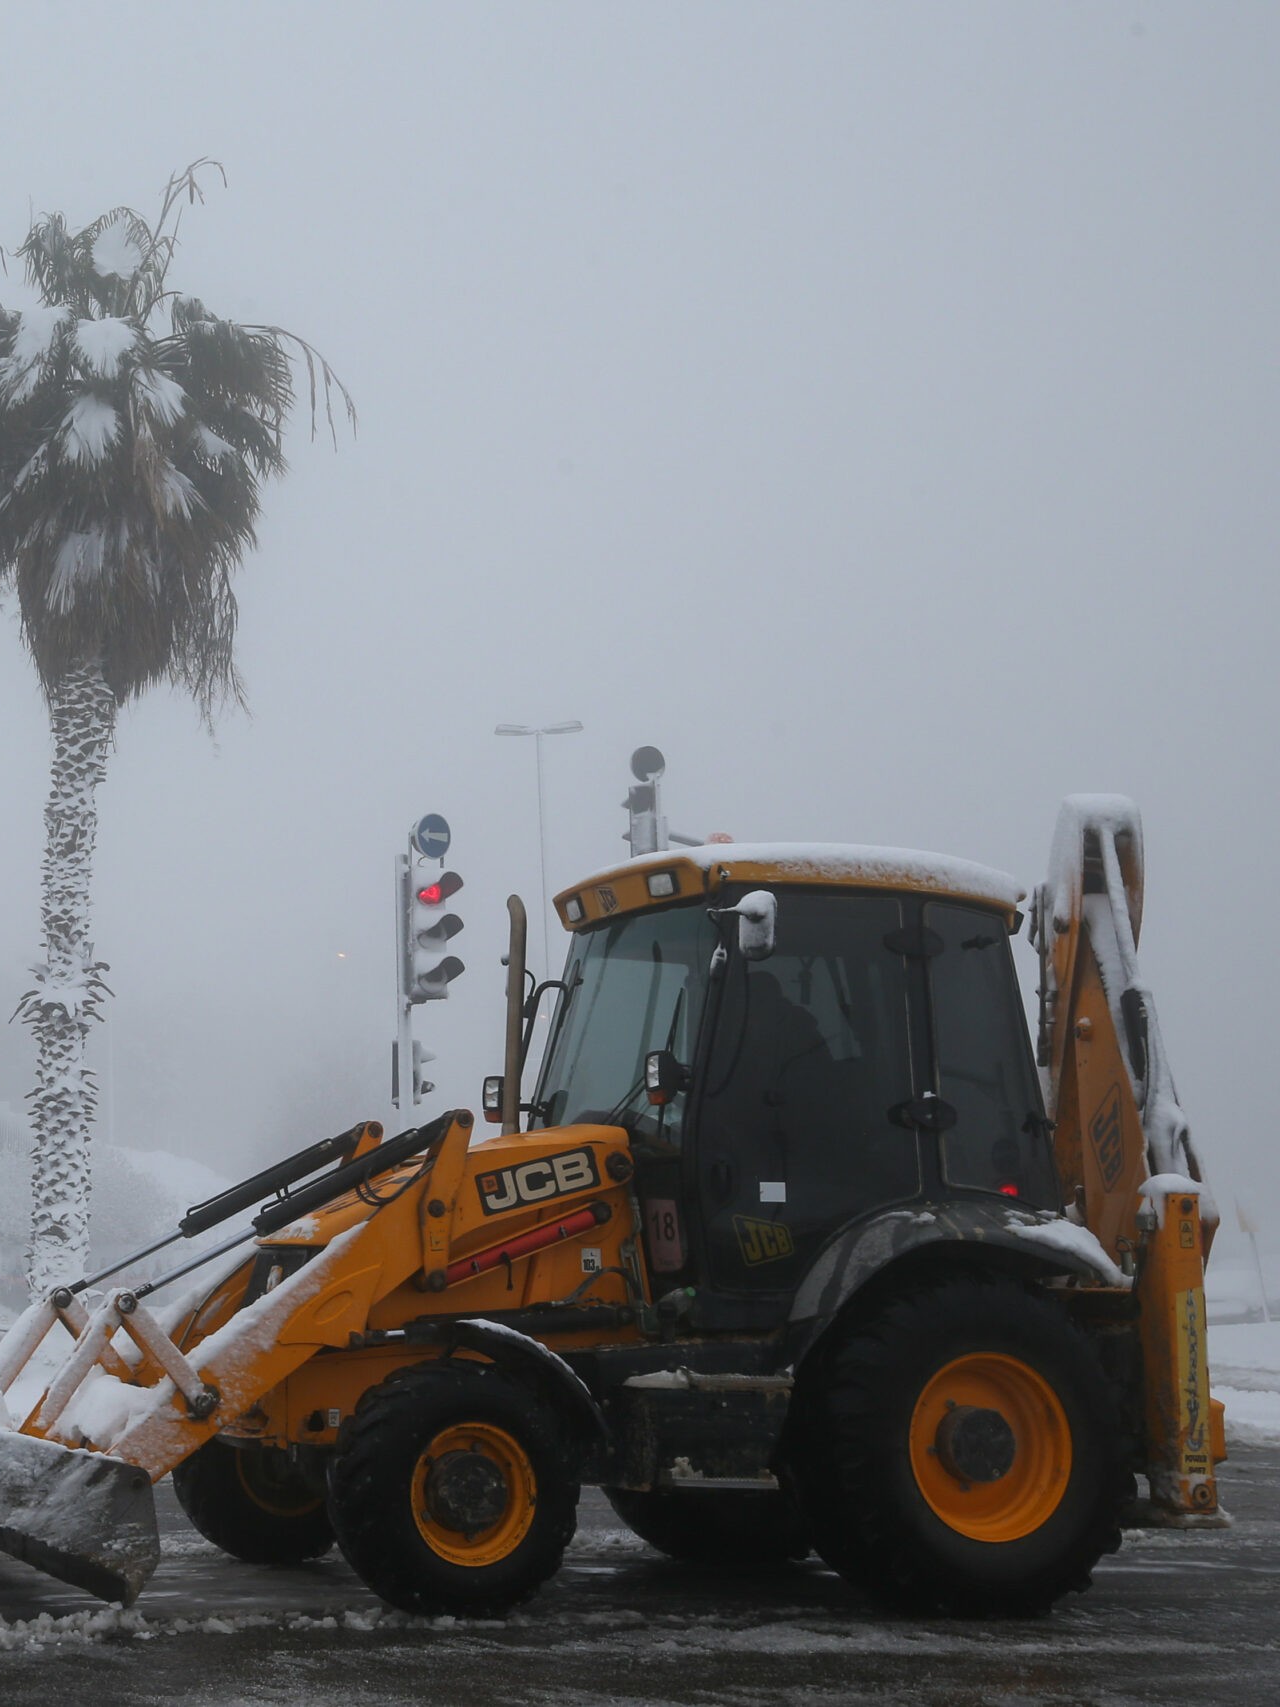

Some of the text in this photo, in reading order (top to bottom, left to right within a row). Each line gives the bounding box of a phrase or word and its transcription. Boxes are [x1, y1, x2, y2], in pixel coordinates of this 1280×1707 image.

[1094, 1101, 1121, 1181] JCB
[485, 1152, 594, 1210] JCB
[651, 1210, 675, 1241] 18
[743, 1221, 790, 1261] JCB
[583, 1258, 595, 1271] 103
